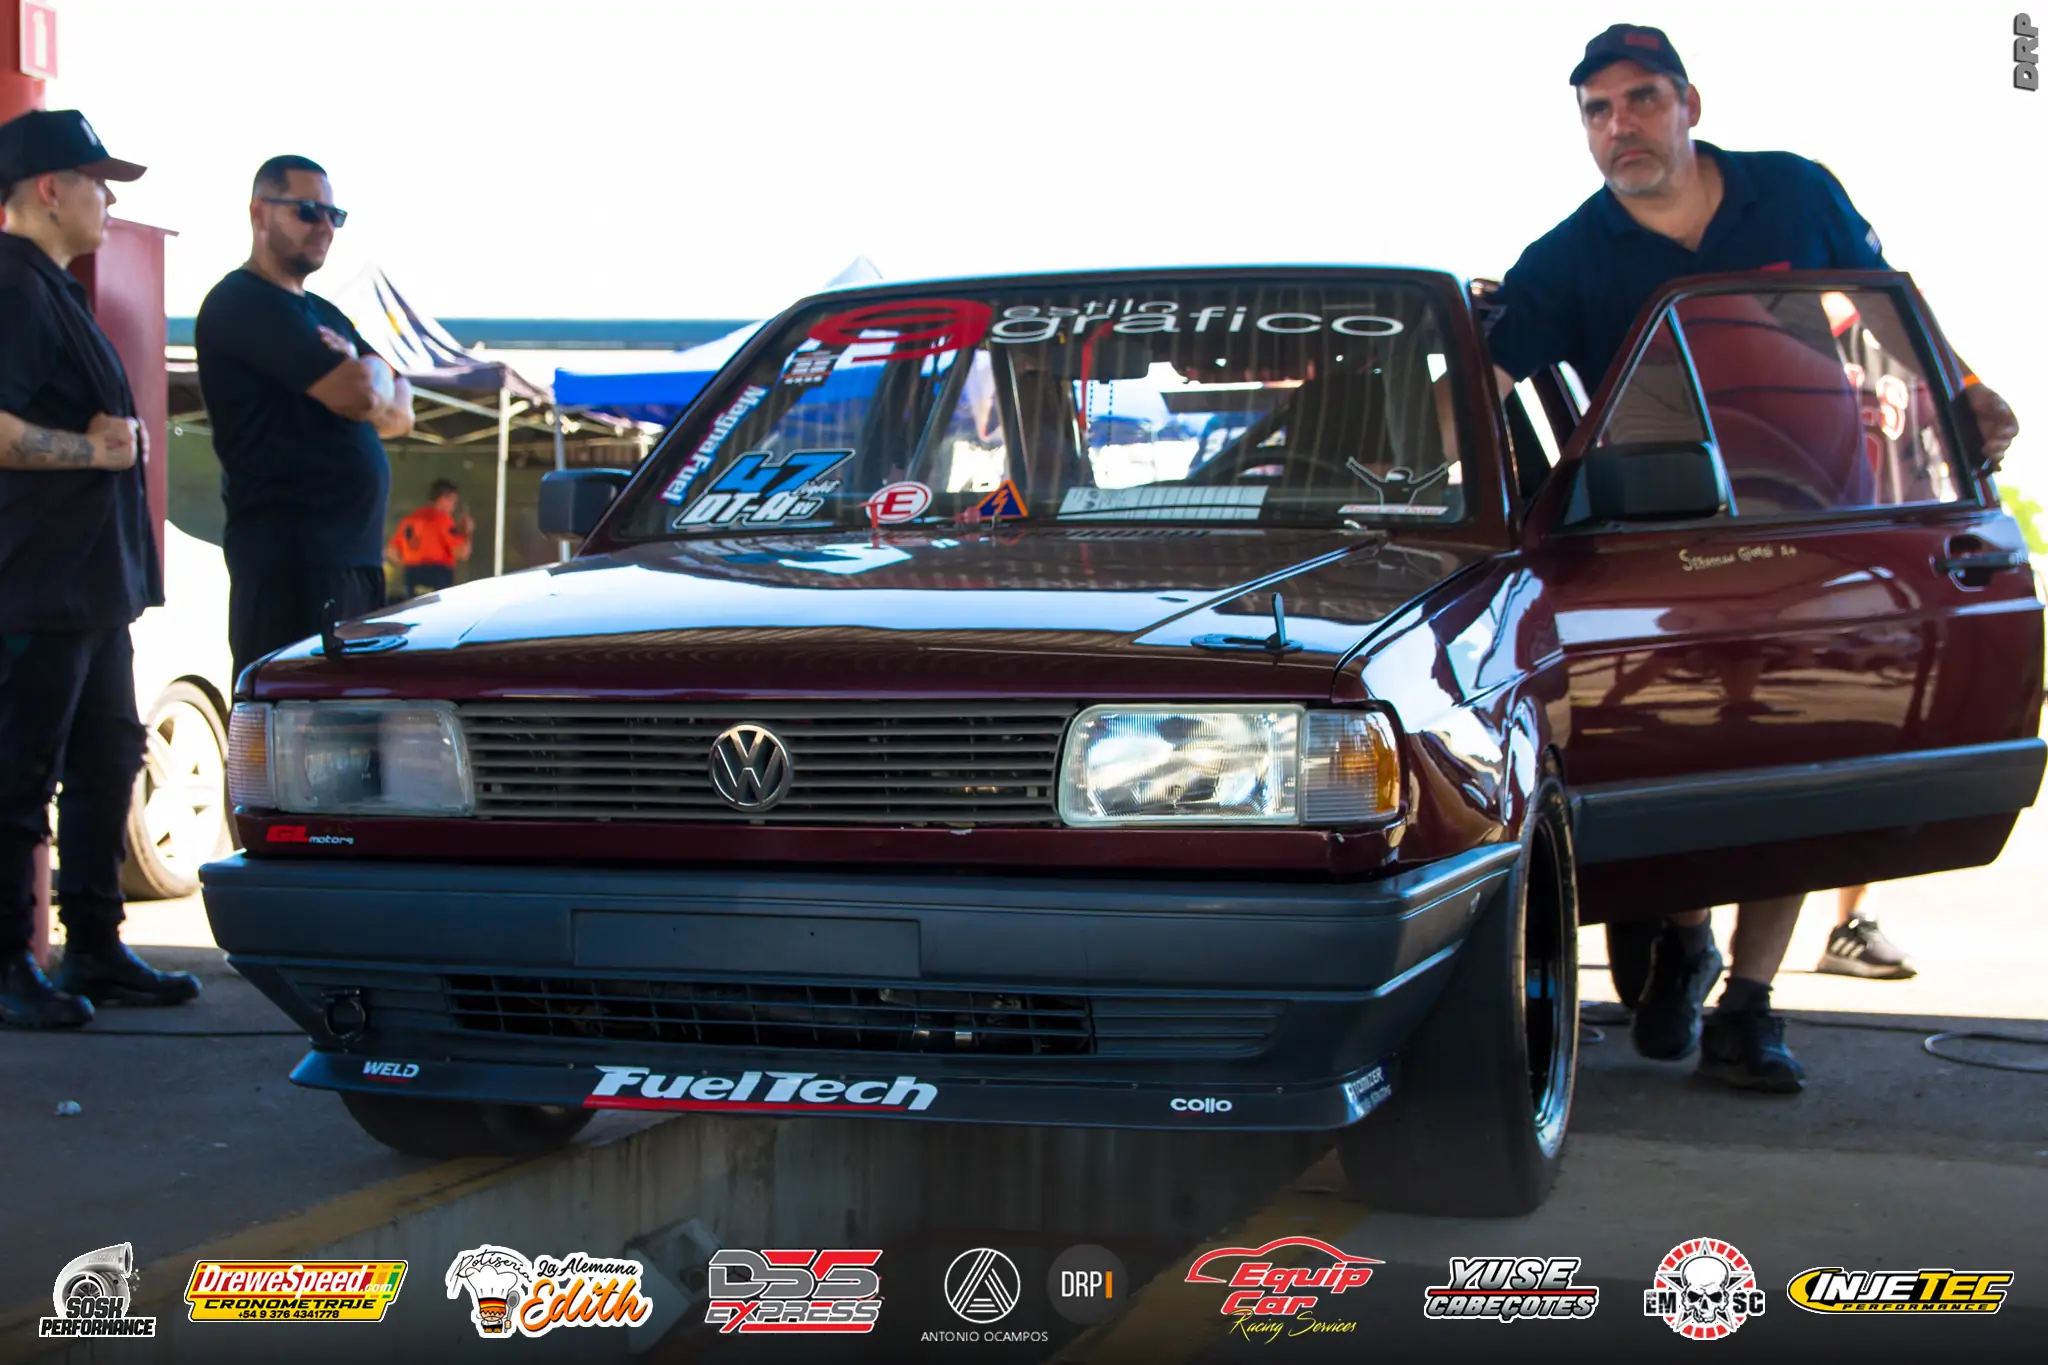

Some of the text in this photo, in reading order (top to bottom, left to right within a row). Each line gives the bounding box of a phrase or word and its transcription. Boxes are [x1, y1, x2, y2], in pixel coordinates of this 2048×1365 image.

[662, 386, 767, 501] MagnaFuel
[712, 452, 849, 498] 47
[880, 490, 918, 516] E
[265, 825, 310, 842] GL
[362, 1061, 420, 1078] WELD
[593, 1065, 939, 1111] FuelTech
[1170, 1097, 1233, 1113] collo
